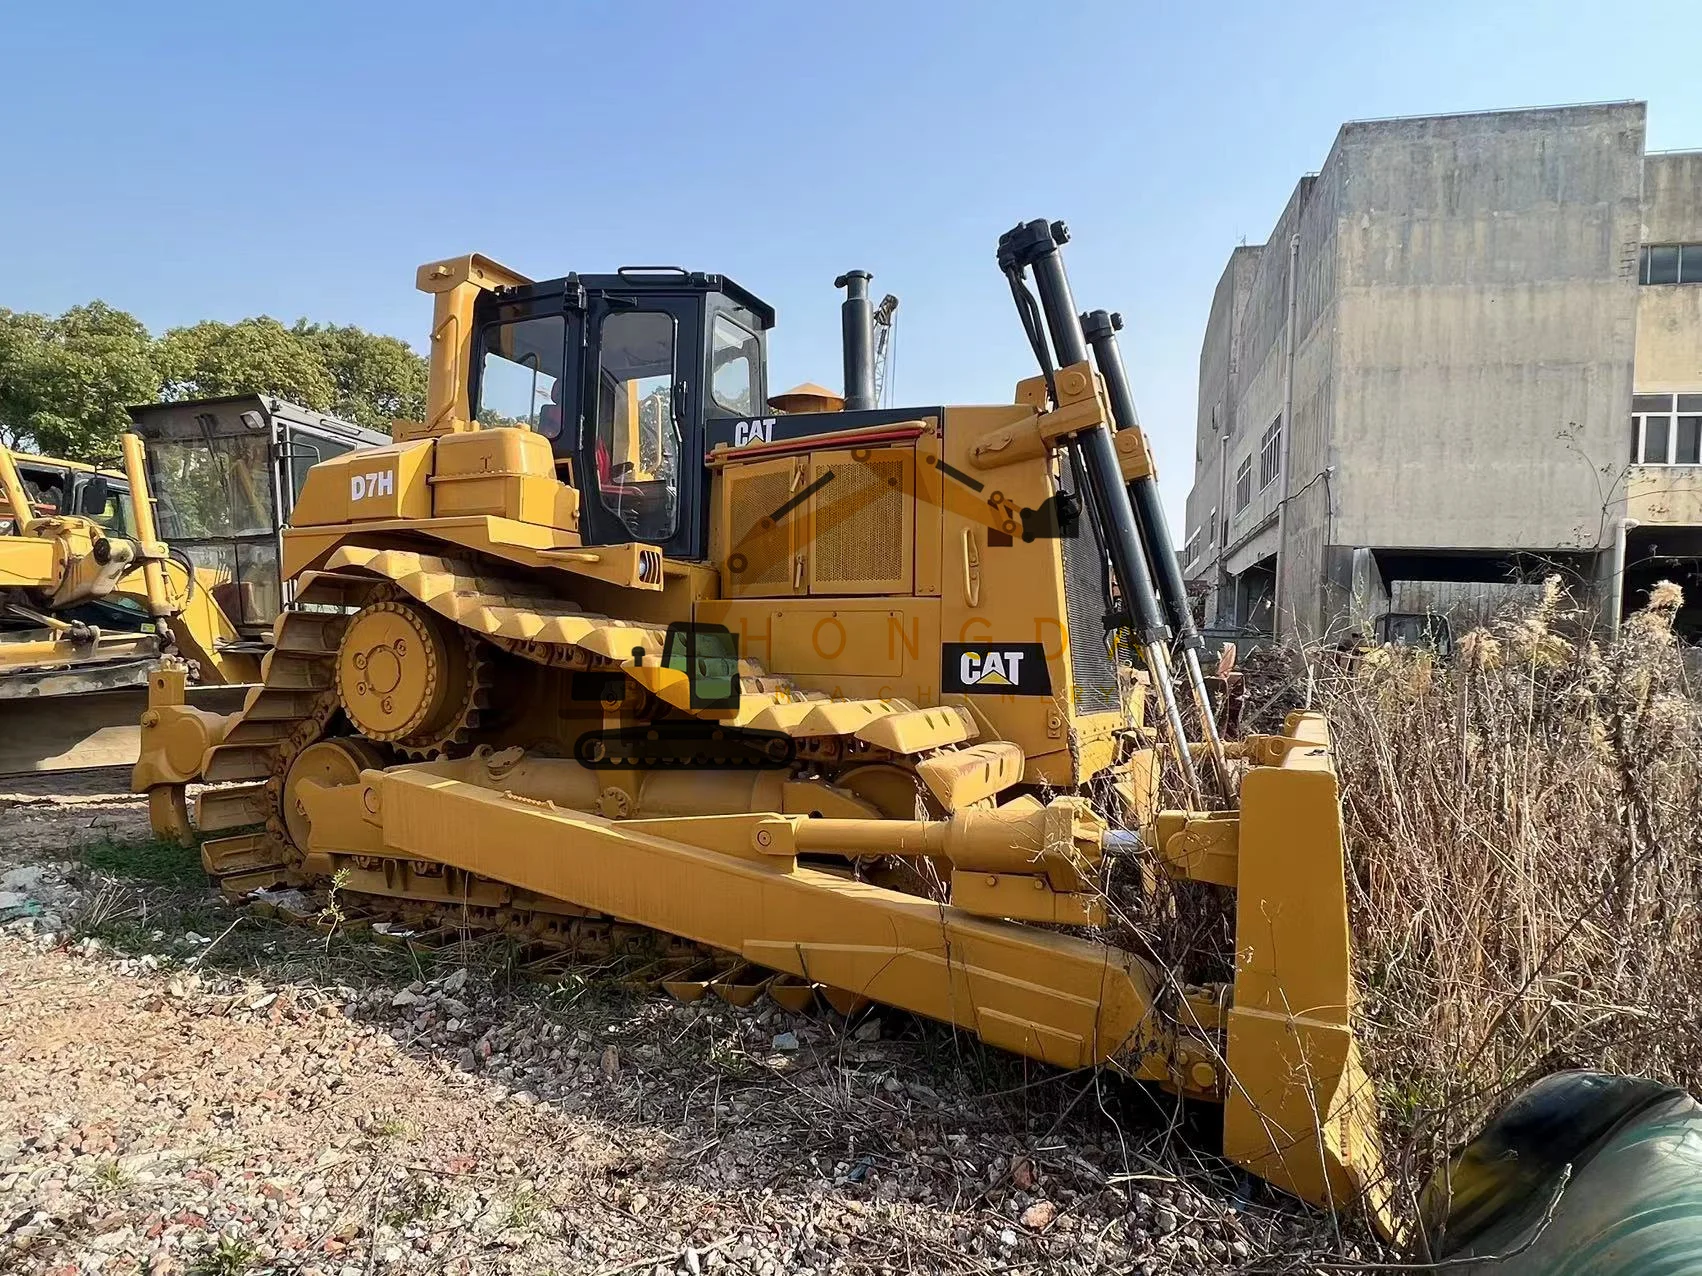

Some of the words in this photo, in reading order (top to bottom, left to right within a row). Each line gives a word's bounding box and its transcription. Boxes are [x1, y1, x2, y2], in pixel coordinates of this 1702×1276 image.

[735, 418, 776, 447] CAT
[351, 470, 393, 501] D7H
[961, 652, 1024, 685] CAT
